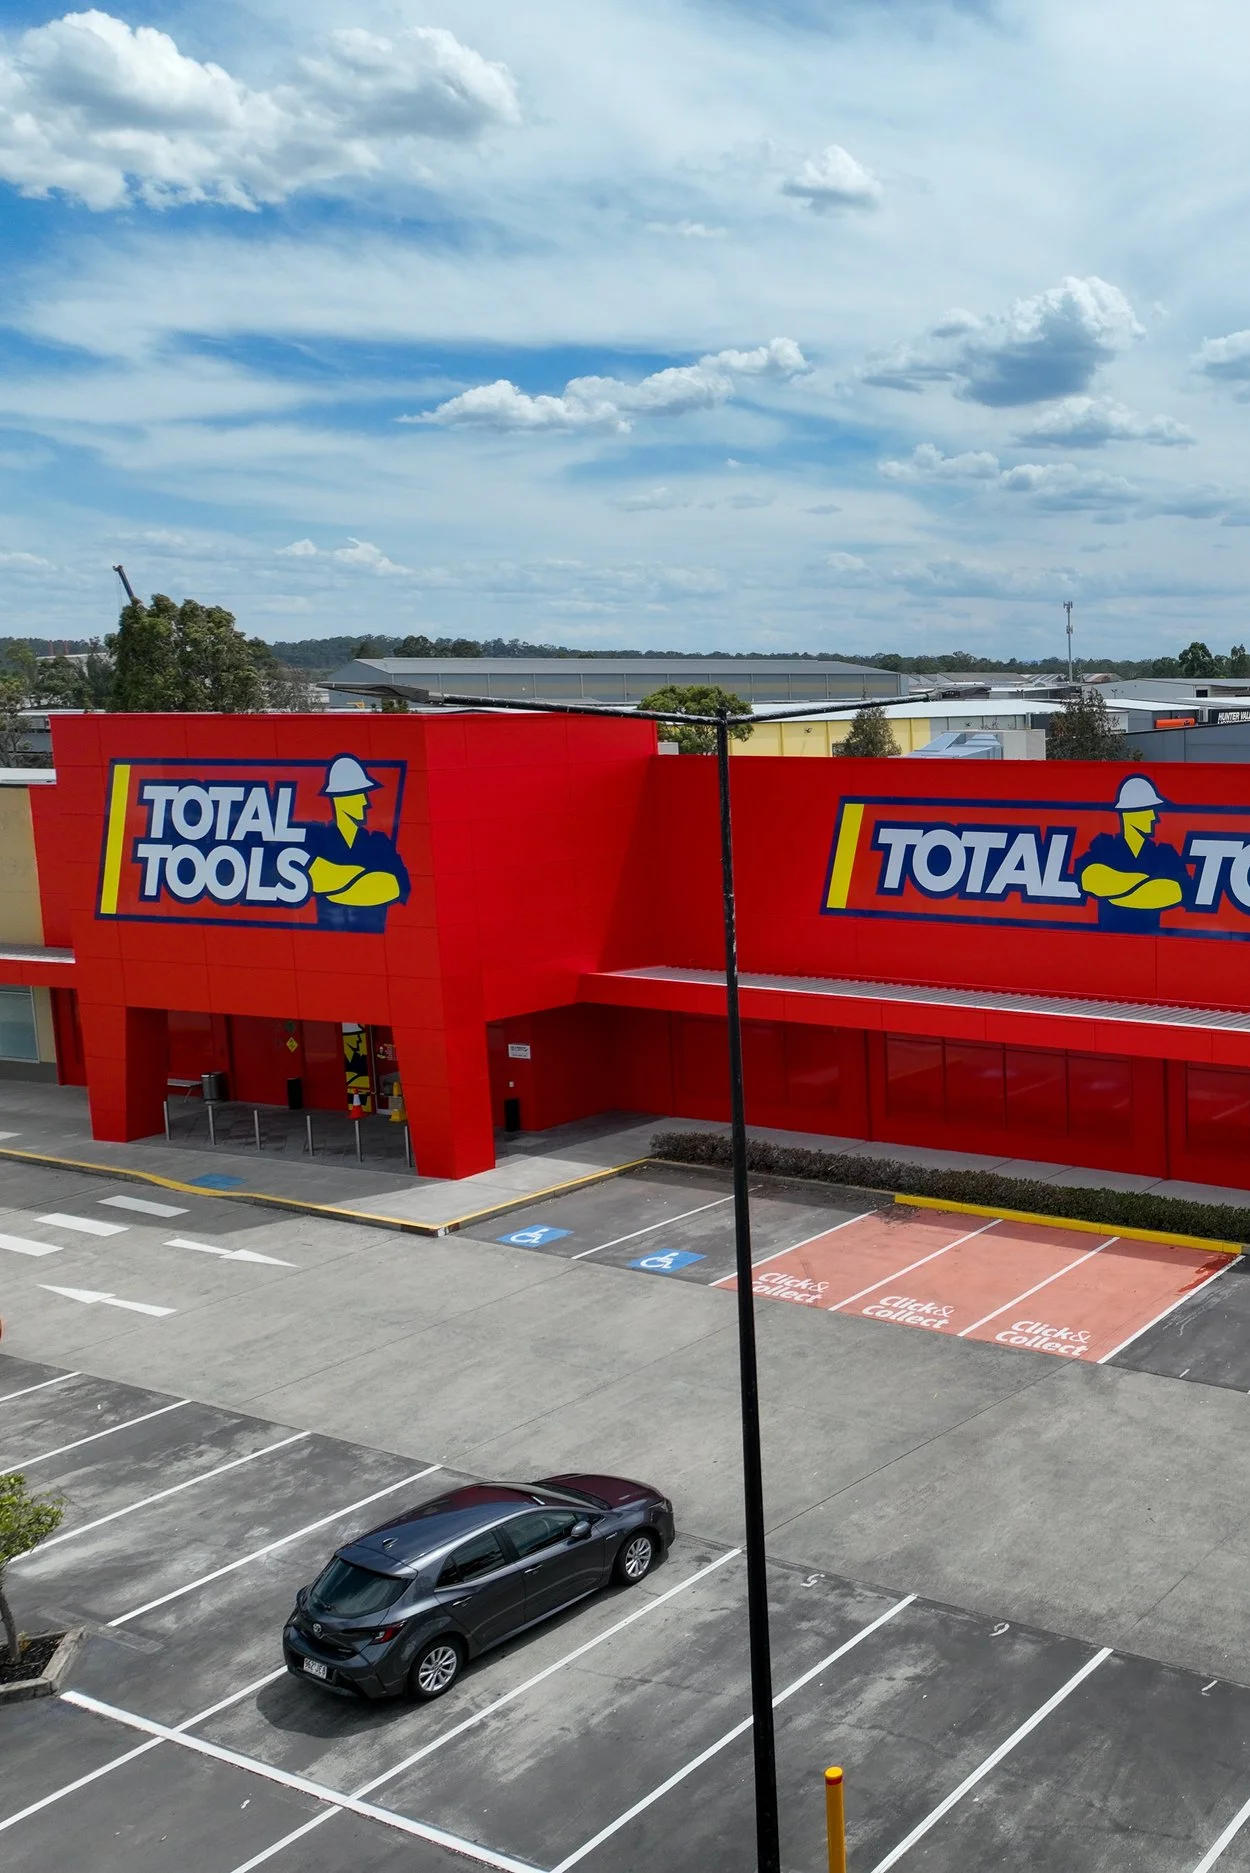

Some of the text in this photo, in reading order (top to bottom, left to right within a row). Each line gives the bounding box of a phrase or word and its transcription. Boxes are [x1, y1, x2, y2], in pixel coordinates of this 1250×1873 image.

[1218, 712, 1240, 721] HUNTER
[143, 785, 307, 842] TOTAL
[137, 843, 310, 903] TOOLS
[878, 828, 1081, 898] TOTAL
[862, 1305, 949, 1329] Collect
[995, 1331, 1089, 1357] Collect
